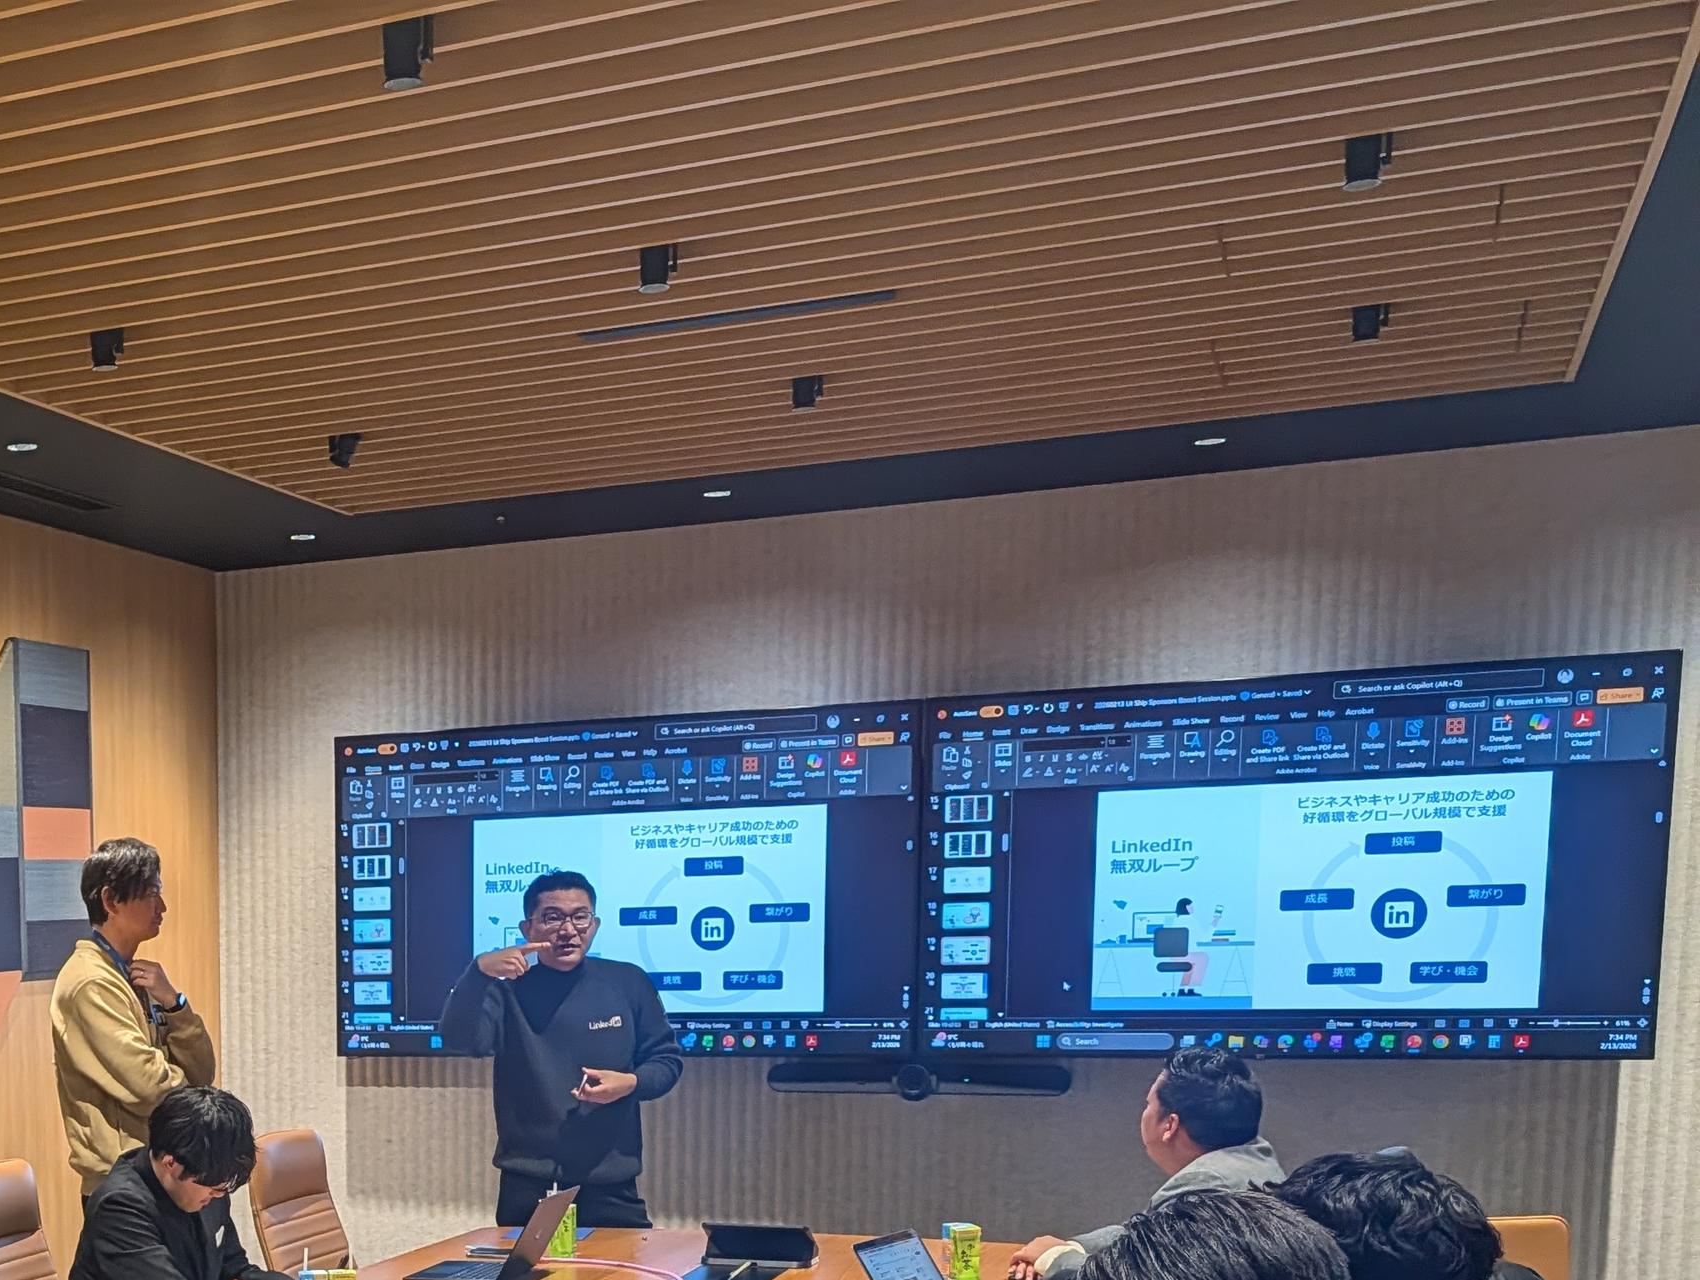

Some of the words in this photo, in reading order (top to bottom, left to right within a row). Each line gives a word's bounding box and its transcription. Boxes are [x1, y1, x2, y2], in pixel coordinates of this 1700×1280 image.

[1406, 680, 1434, 690] Copilot
[1435, 679, 1463, 689] (Alt+Q)
[1459, 700, 1485, 709] Record
[1507, 698, 1534, 706] Present
[1544, 695, 1568, 703] Teams
[1318, 710, 1335, 718] Help
[1345, 708, 1374, 716] Acrobat
[1489, 735, 1513, 743] Design
[1526, 733, 1552, 741] Copilot
[1564, 731, 1601, 739] Document
[1396, 738, 1430, 747] Sensitivity
[1480, 743, 1522, 752] Suggestions
[1571, 739, 1592, 747] Cloud
[1180, 750, 1205, 758] Drawing
[804, 770, 825, 778] Copilot
[1297, 788, 1515, 809] ビジネスやキャリア成功のための
[1302, 804, 1507, 824] 好循環をグローバル規模で支援
[630, 819, 799, 837] ビジネスやキャリア成功のための
[634, 833, 792, 850] 好循環をグローバル規模で支援
[1111, 838, 1192, 854] LinkedIn
[1391, 836, 1415, 847] 投稿
[485, 861, 550, 875] LinkedIn
[704, 860, 724, 870] 投稿
[1110, 856, 1199, 874] 無双ループ
[1304, 893, 1328, 904] 成長
[1468, 888, 1503, 899] 繋がり
[638, 910, 657, 920] 成長
[1387, 905, 1410, 924] in
[704, 921, 721, 938] in
[1332, 967, 1356, 977] 挑戦
[1419, 965, 1477, 976] 学び・機会
[1076, 1037, 1099, 1046] Search
